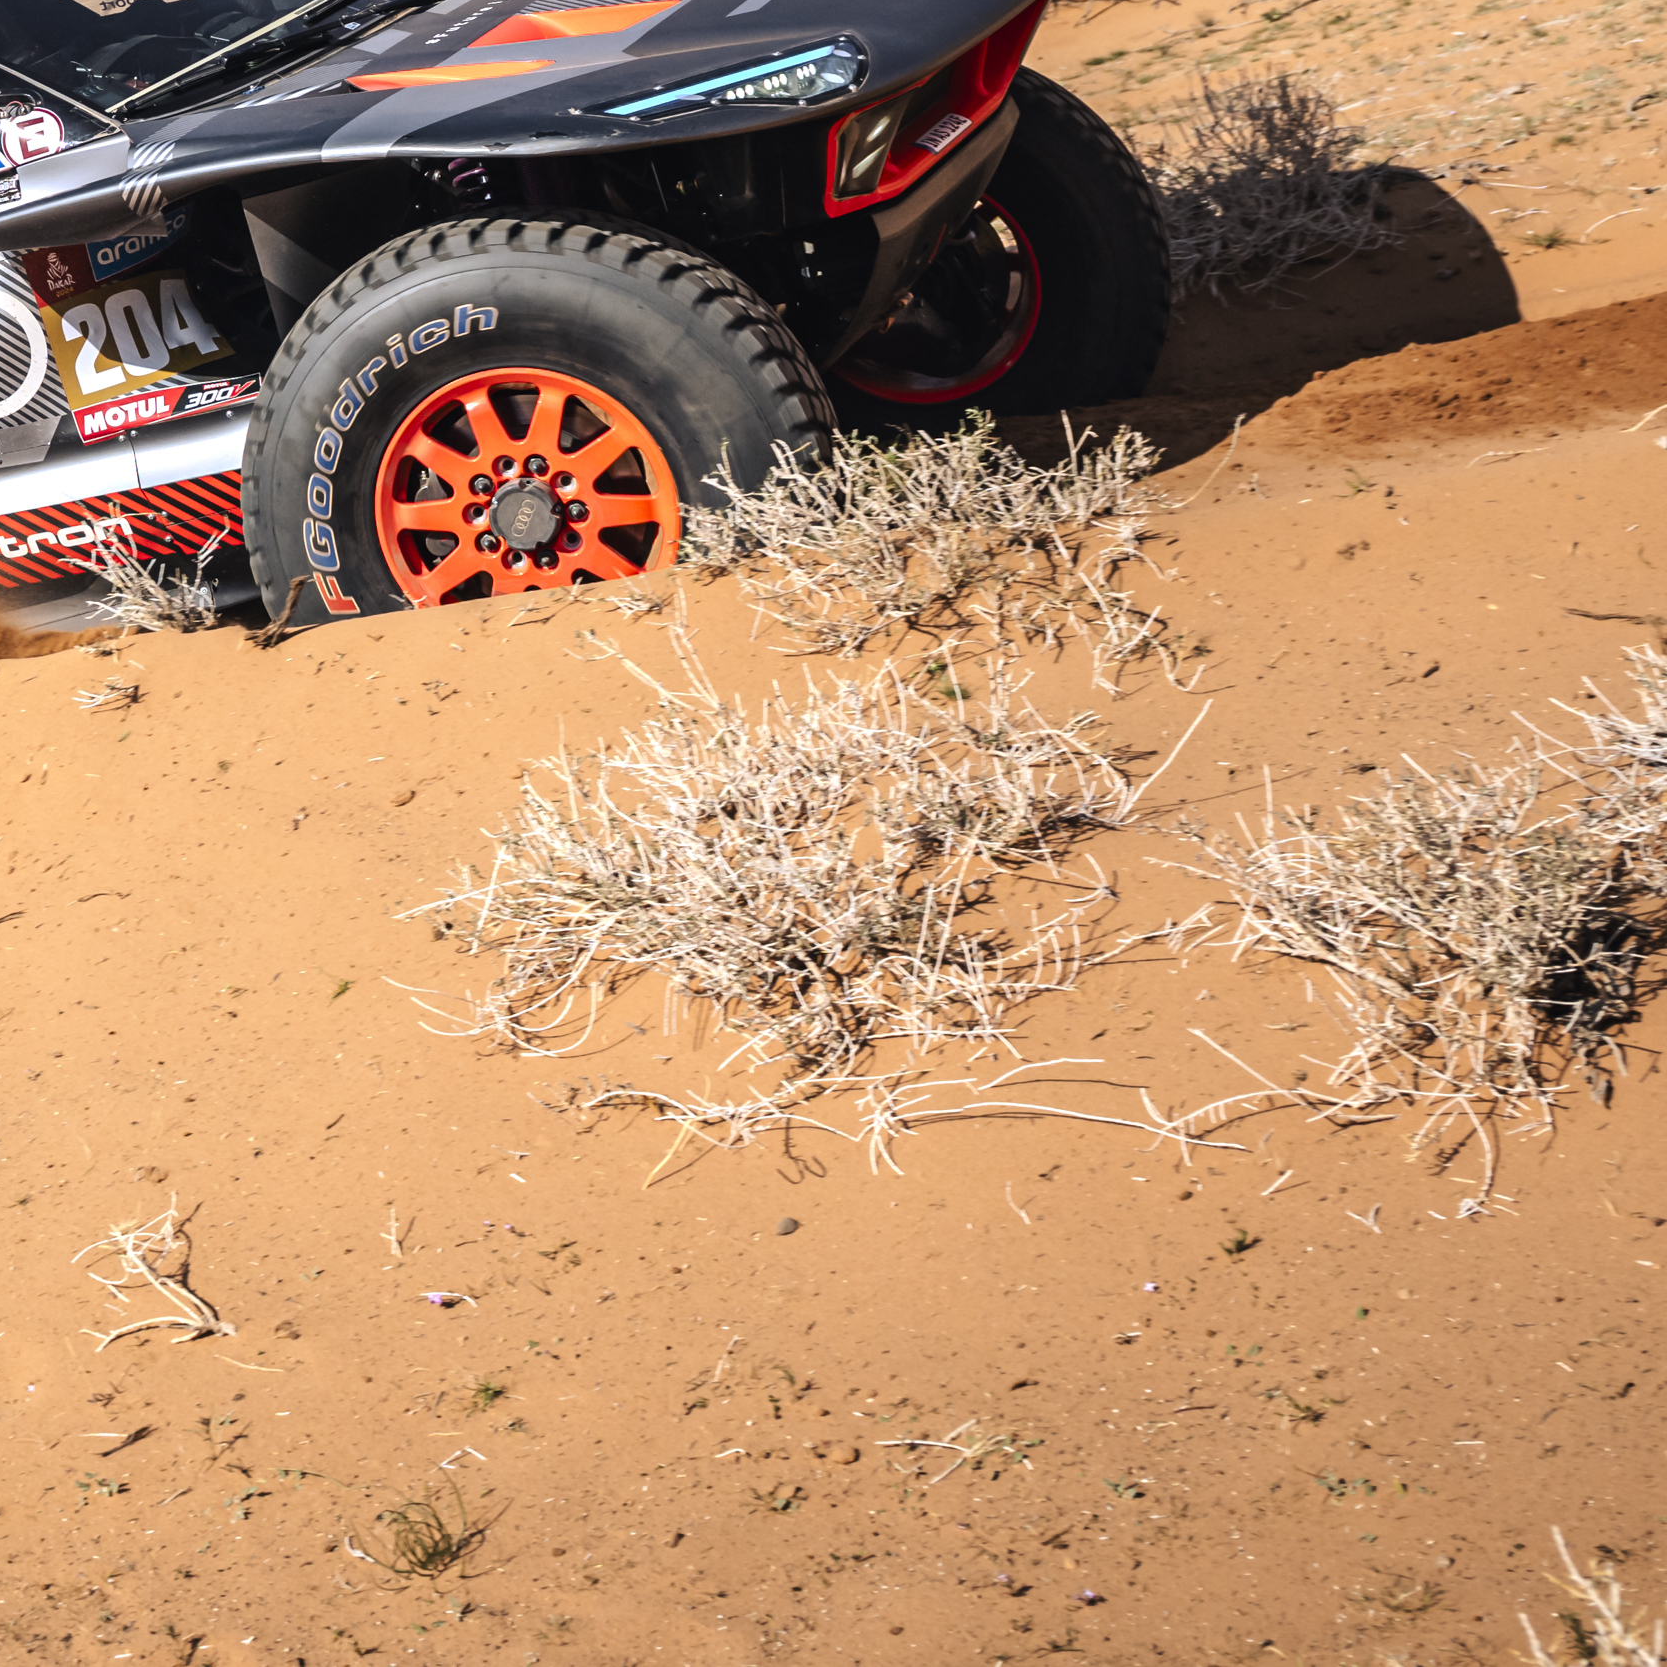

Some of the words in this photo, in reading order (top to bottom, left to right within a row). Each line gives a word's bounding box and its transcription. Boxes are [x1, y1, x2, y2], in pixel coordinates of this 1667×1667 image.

[47, 273, 76, 292] DAKAR
[61, 278, 221, 396] 204
[184, 379, 257, 410] 300V
[203, 381, 229, 391] MOTUL
[84, 395, 170, 436] MOTUL
[302, 302, 499, 615] FGoodrich
